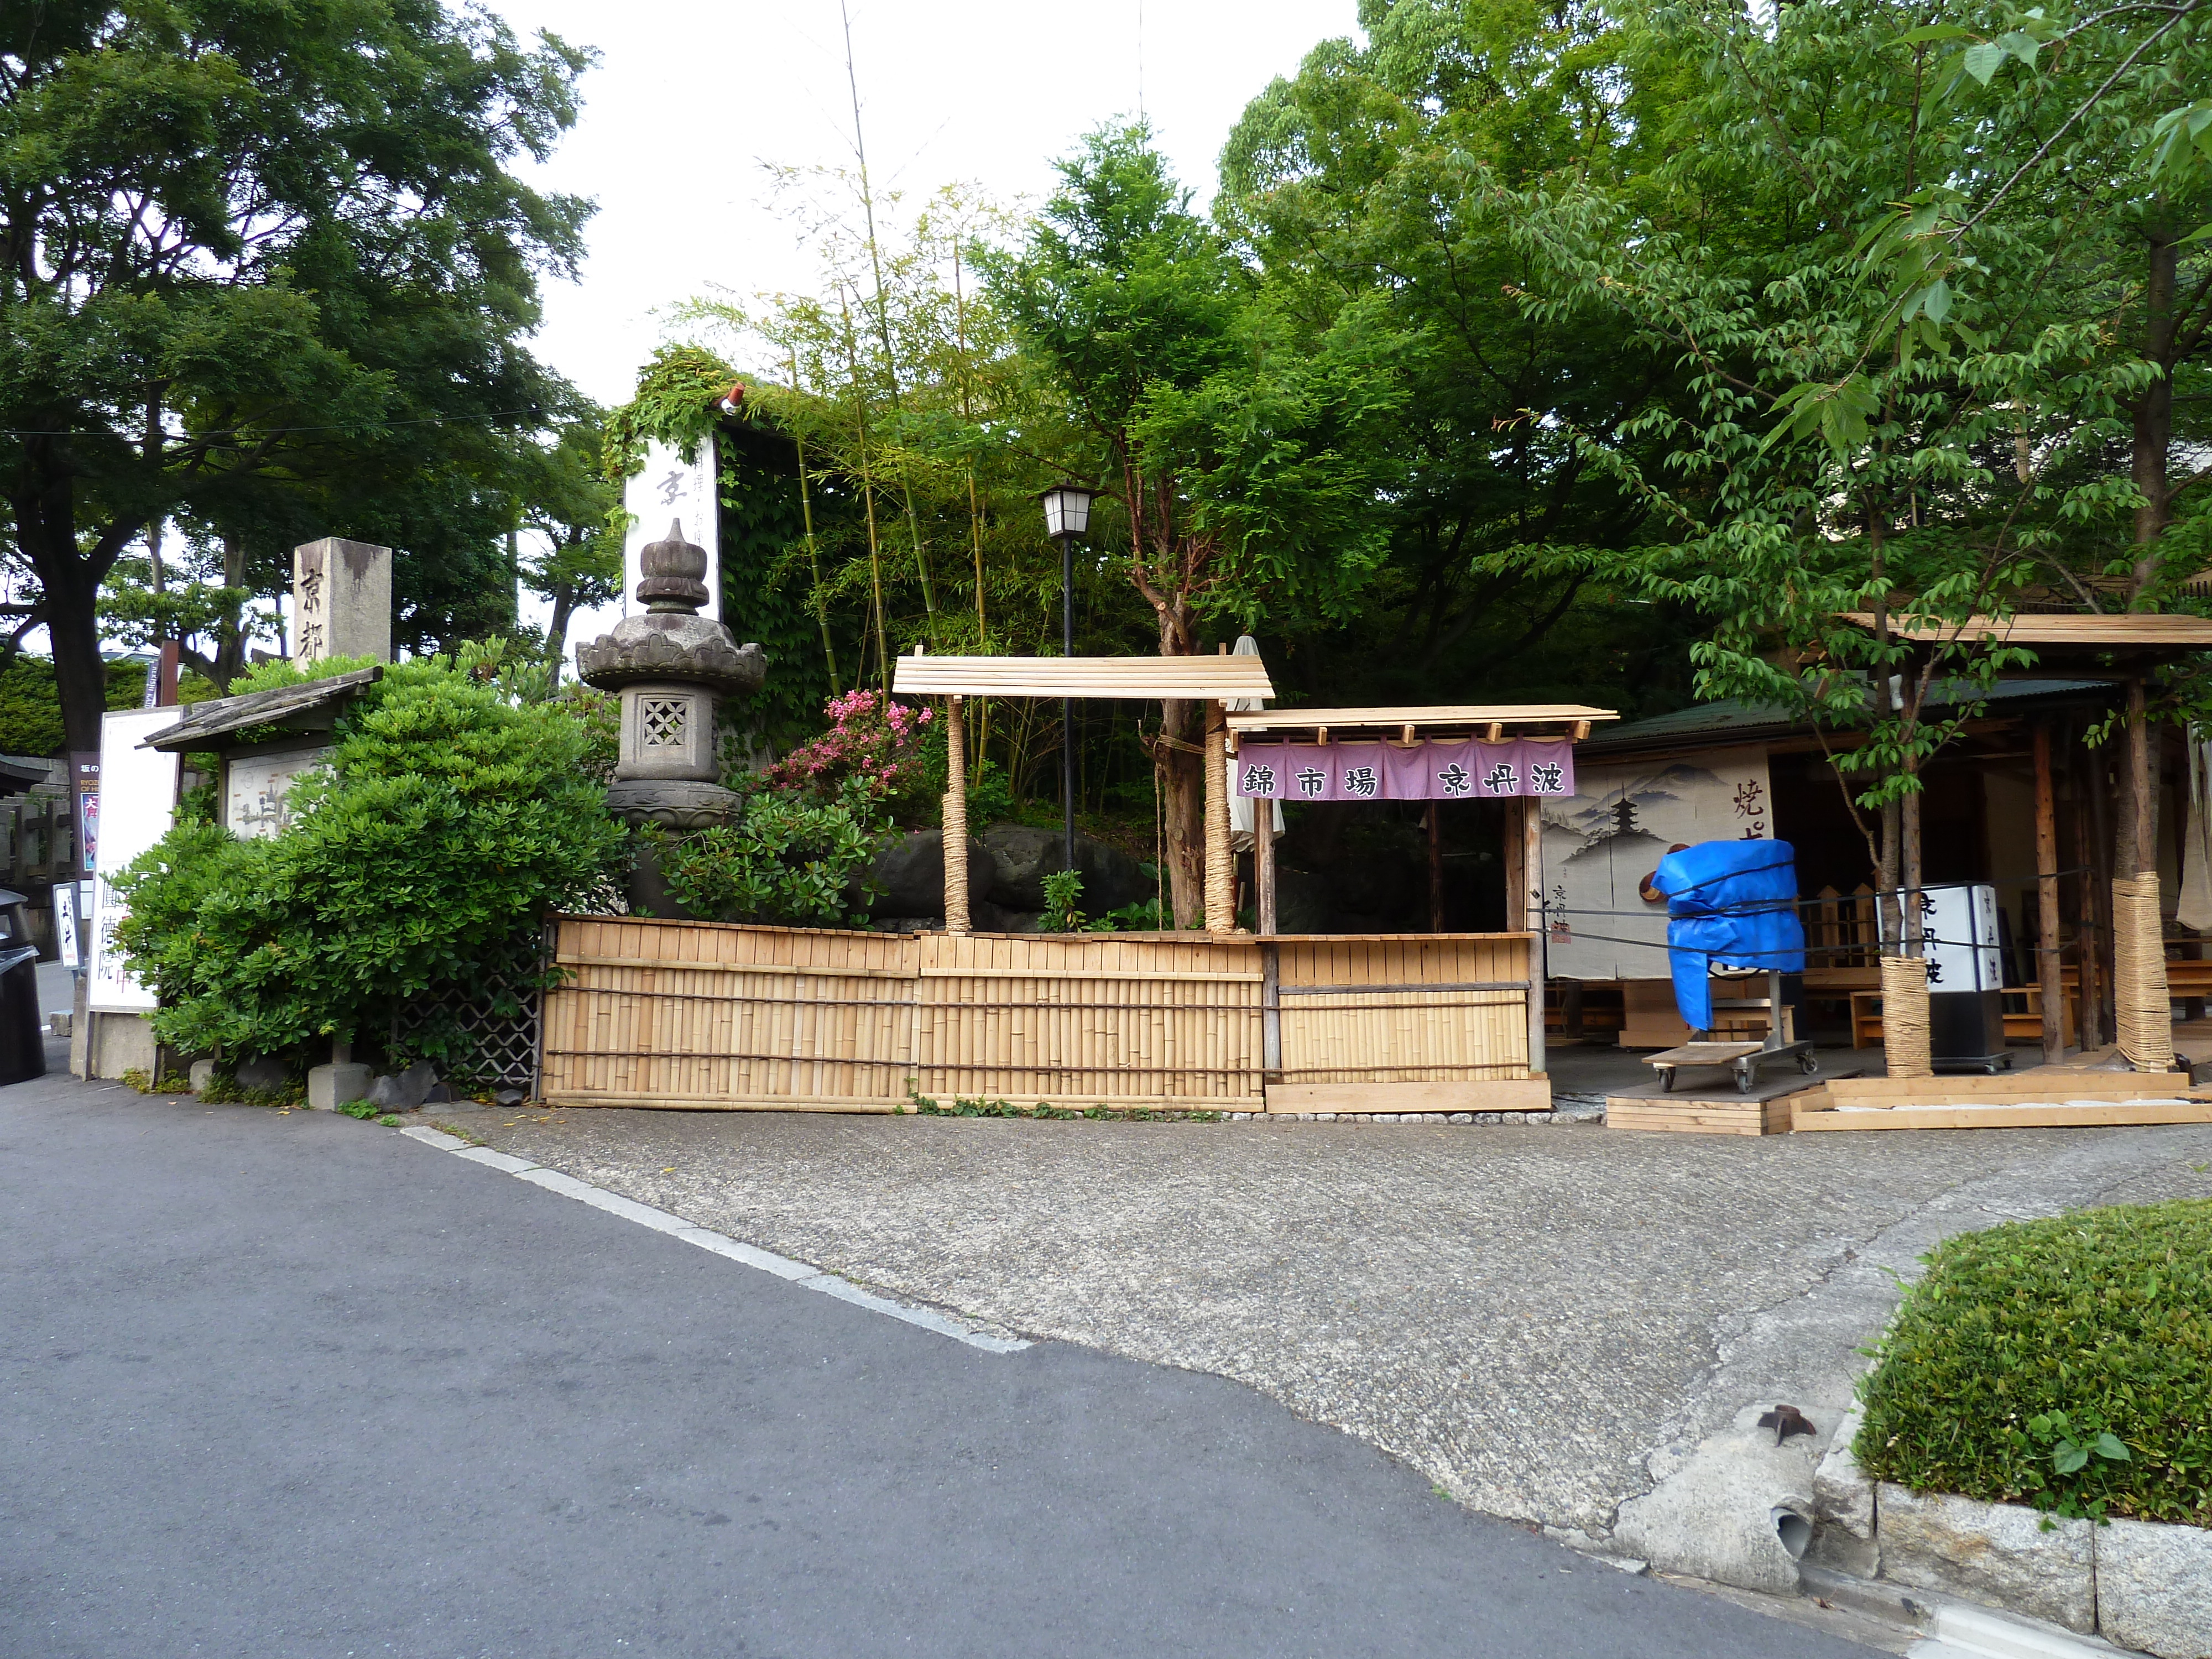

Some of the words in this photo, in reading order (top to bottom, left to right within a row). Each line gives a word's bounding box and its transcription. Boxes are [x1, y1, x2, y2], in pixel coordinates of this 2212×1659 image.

[299, 567, 323, 661] 京都
[1242, 764, 1379, 799] 錦市場
[1437, 762, 1566, 797] 京丹波
